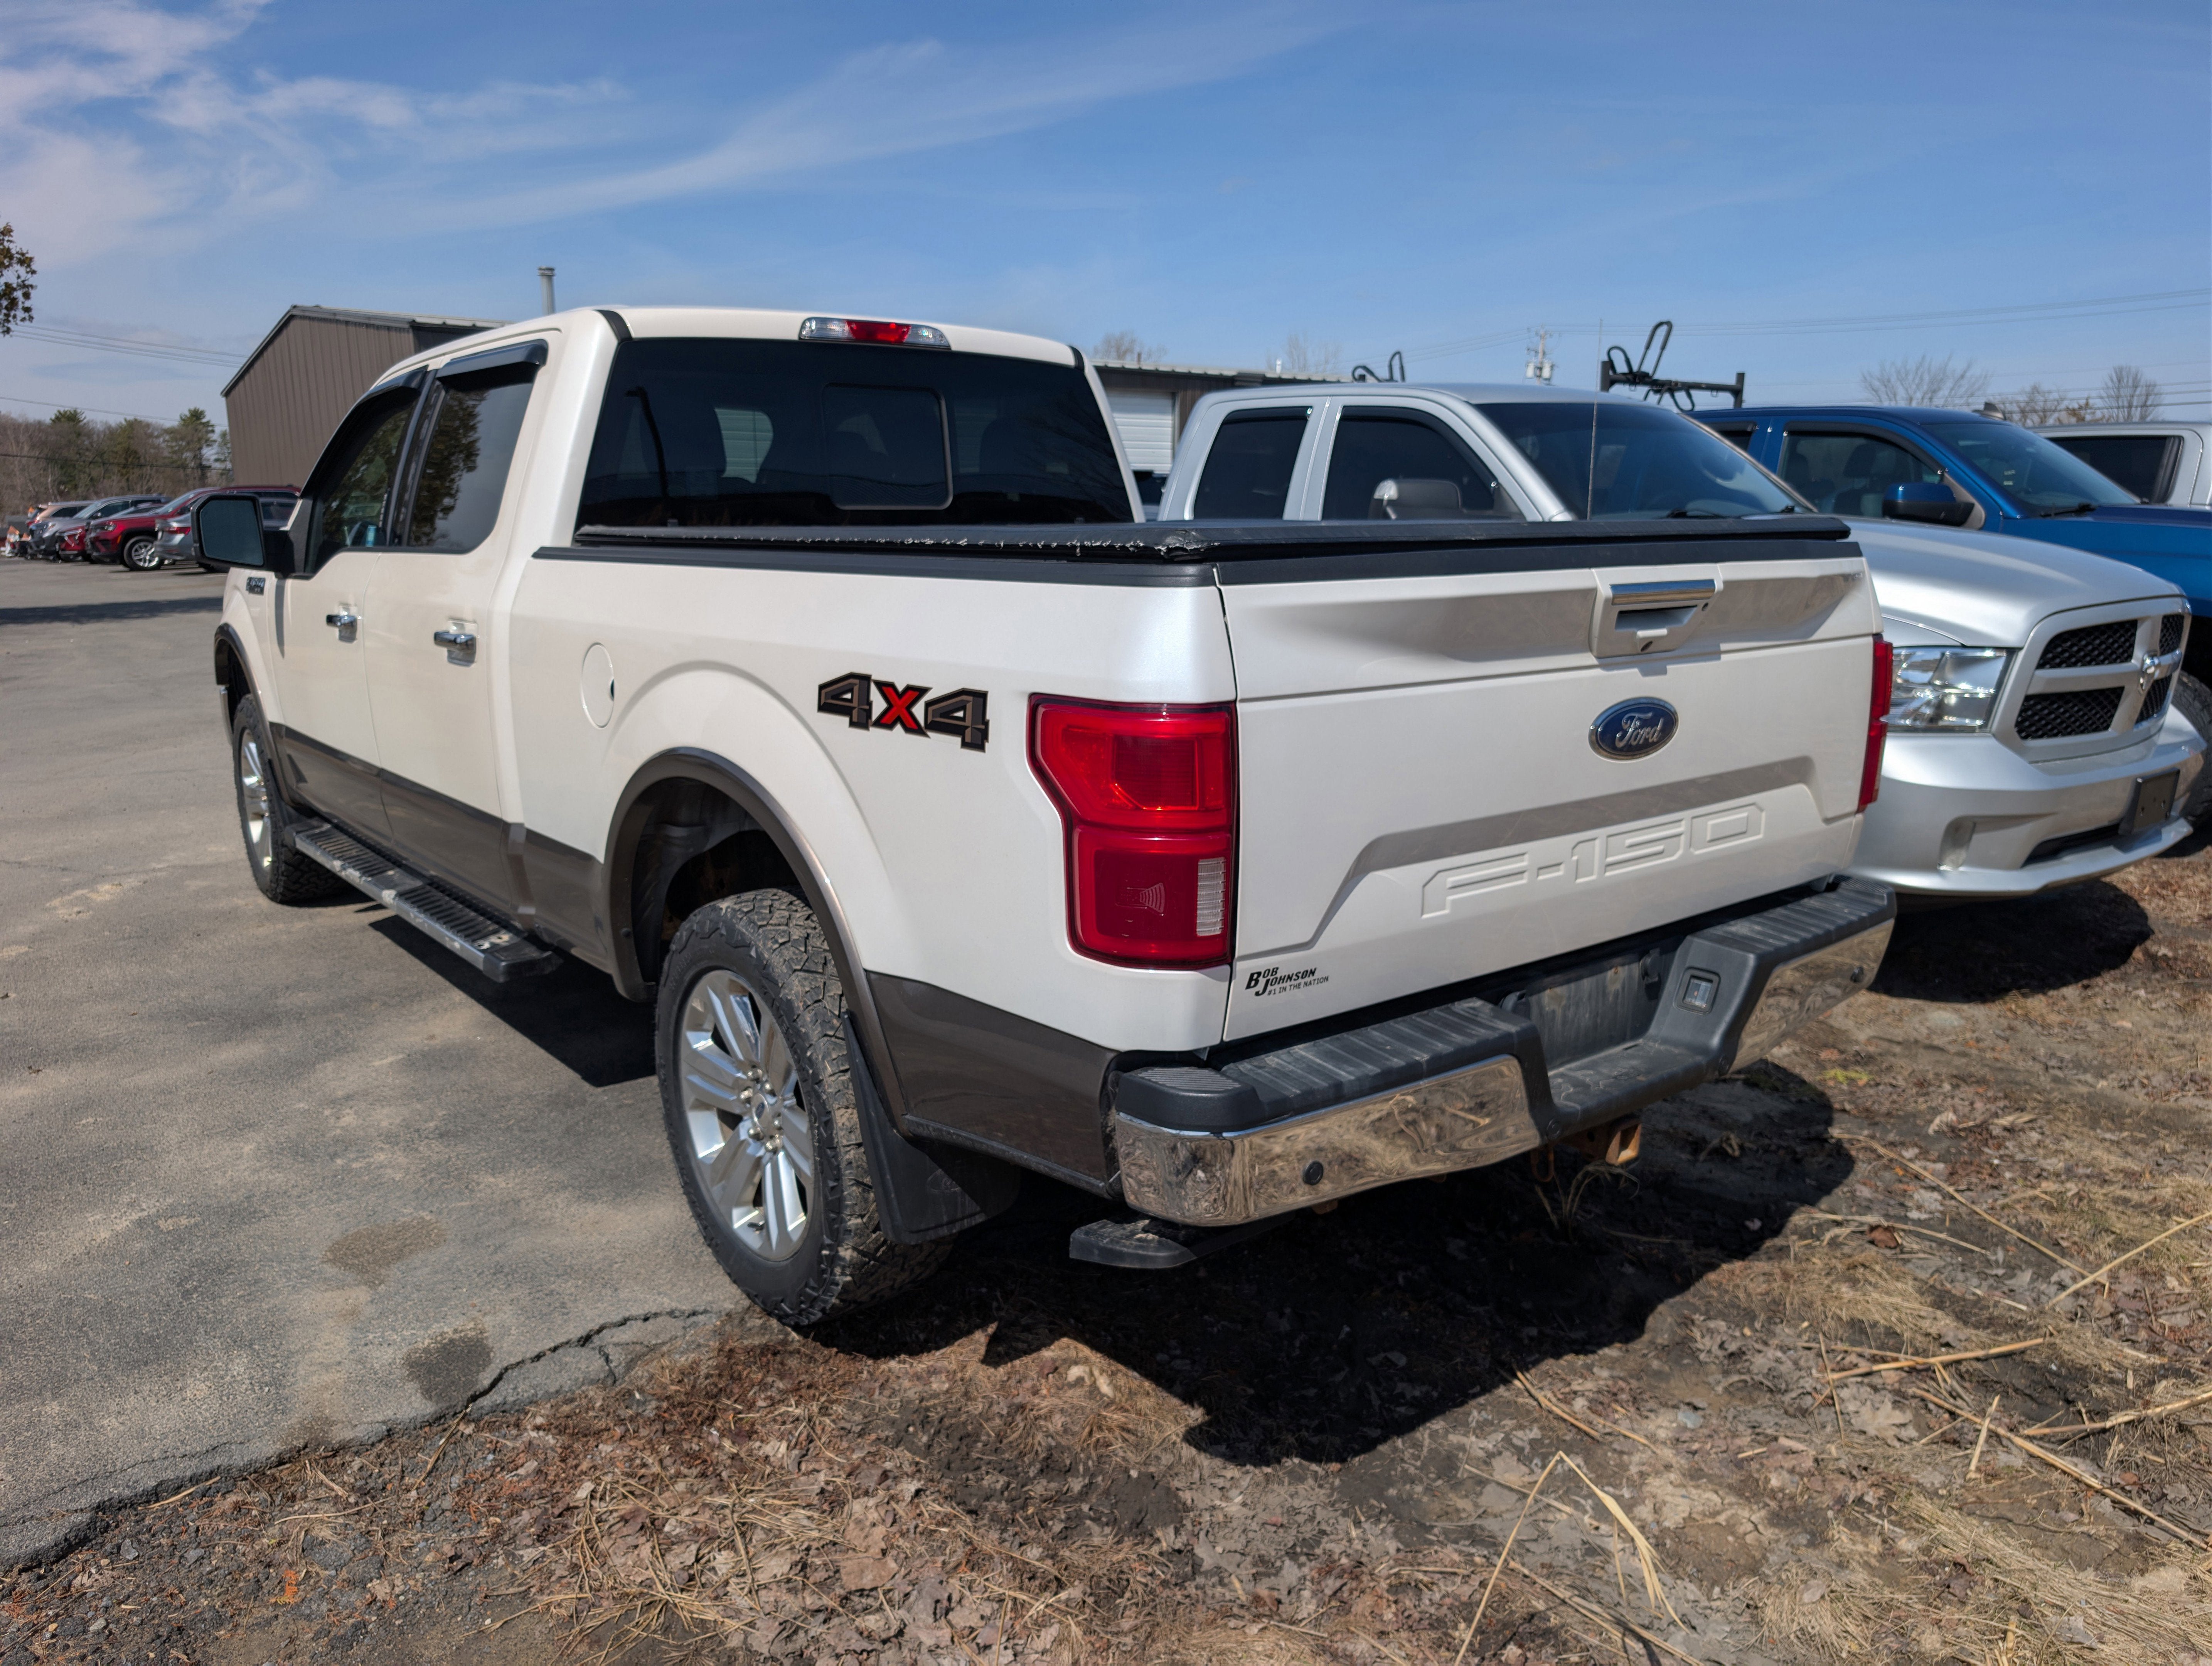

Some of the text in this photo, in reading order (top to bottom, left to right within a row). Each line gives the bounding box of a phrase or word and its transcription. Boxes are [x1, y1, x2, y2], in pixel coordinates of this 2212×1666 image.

[817, 672, 990, 753] 4X4
[1615, 711, 1664, 748] Ford
[1421, 802, 1765, 919] F-150
[1245, 966, 1279, 990] BOB
[1255, 967, 1317, 997] JOHNSON
[1279, 985, 1287, 993] IN
[1289, 982, 1301, 991] THE
[1303, 975, 1329, 988] NATION
